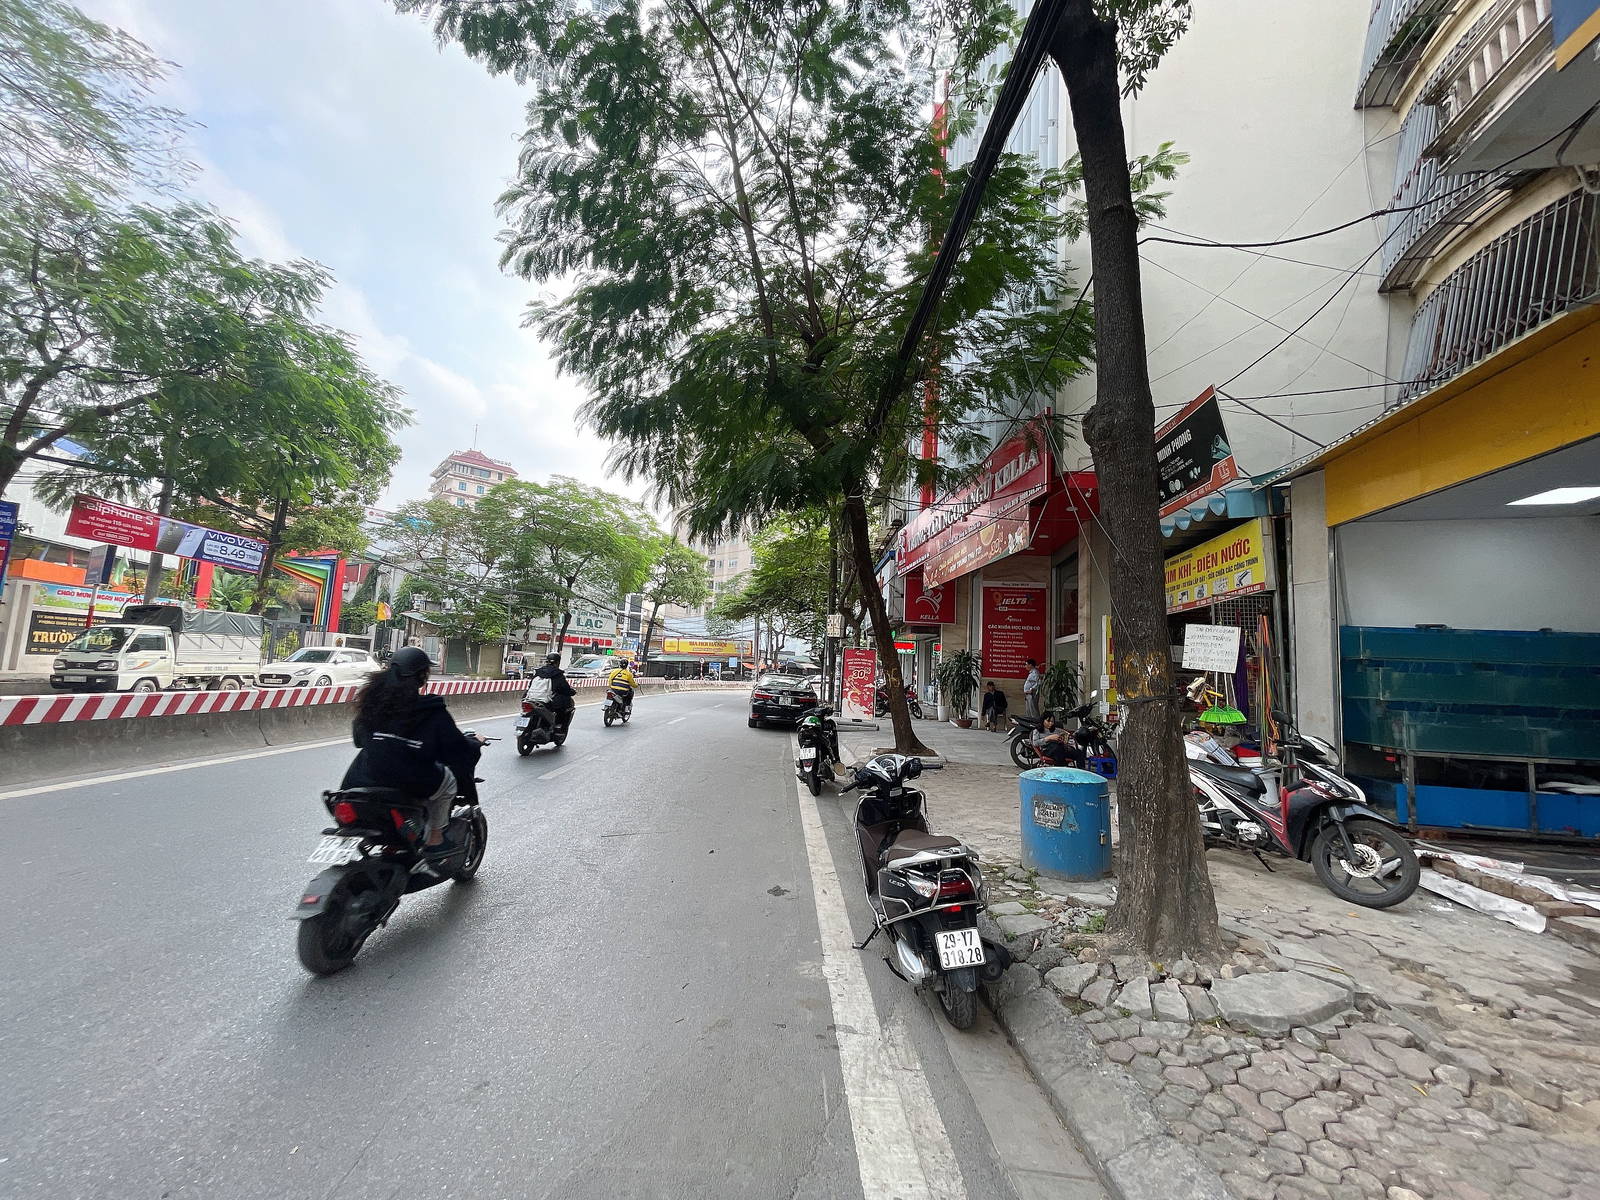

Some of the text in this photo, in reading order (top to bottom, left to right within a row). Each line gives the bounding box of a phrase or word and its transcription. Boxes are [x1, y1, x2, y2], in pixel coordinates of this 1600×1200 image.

[1171, 429, 1192, 452] PHONG
[994, 448, 1041, 493] KELLA
[219, 545, 246, 559] 8.49
[1179, 560, 1191, 580] KHÍ
[1197, 552, 1217, 573] ĐIỆN
[1221, 538, 1250, 564] NƯỚC
[33, 629, 77, 643] TRƯỜN
[1040, 809, 1055, 817] 24H
[943, 931, 973, 949] 29-Y7
[943, 947, 982, 966] 318.28
